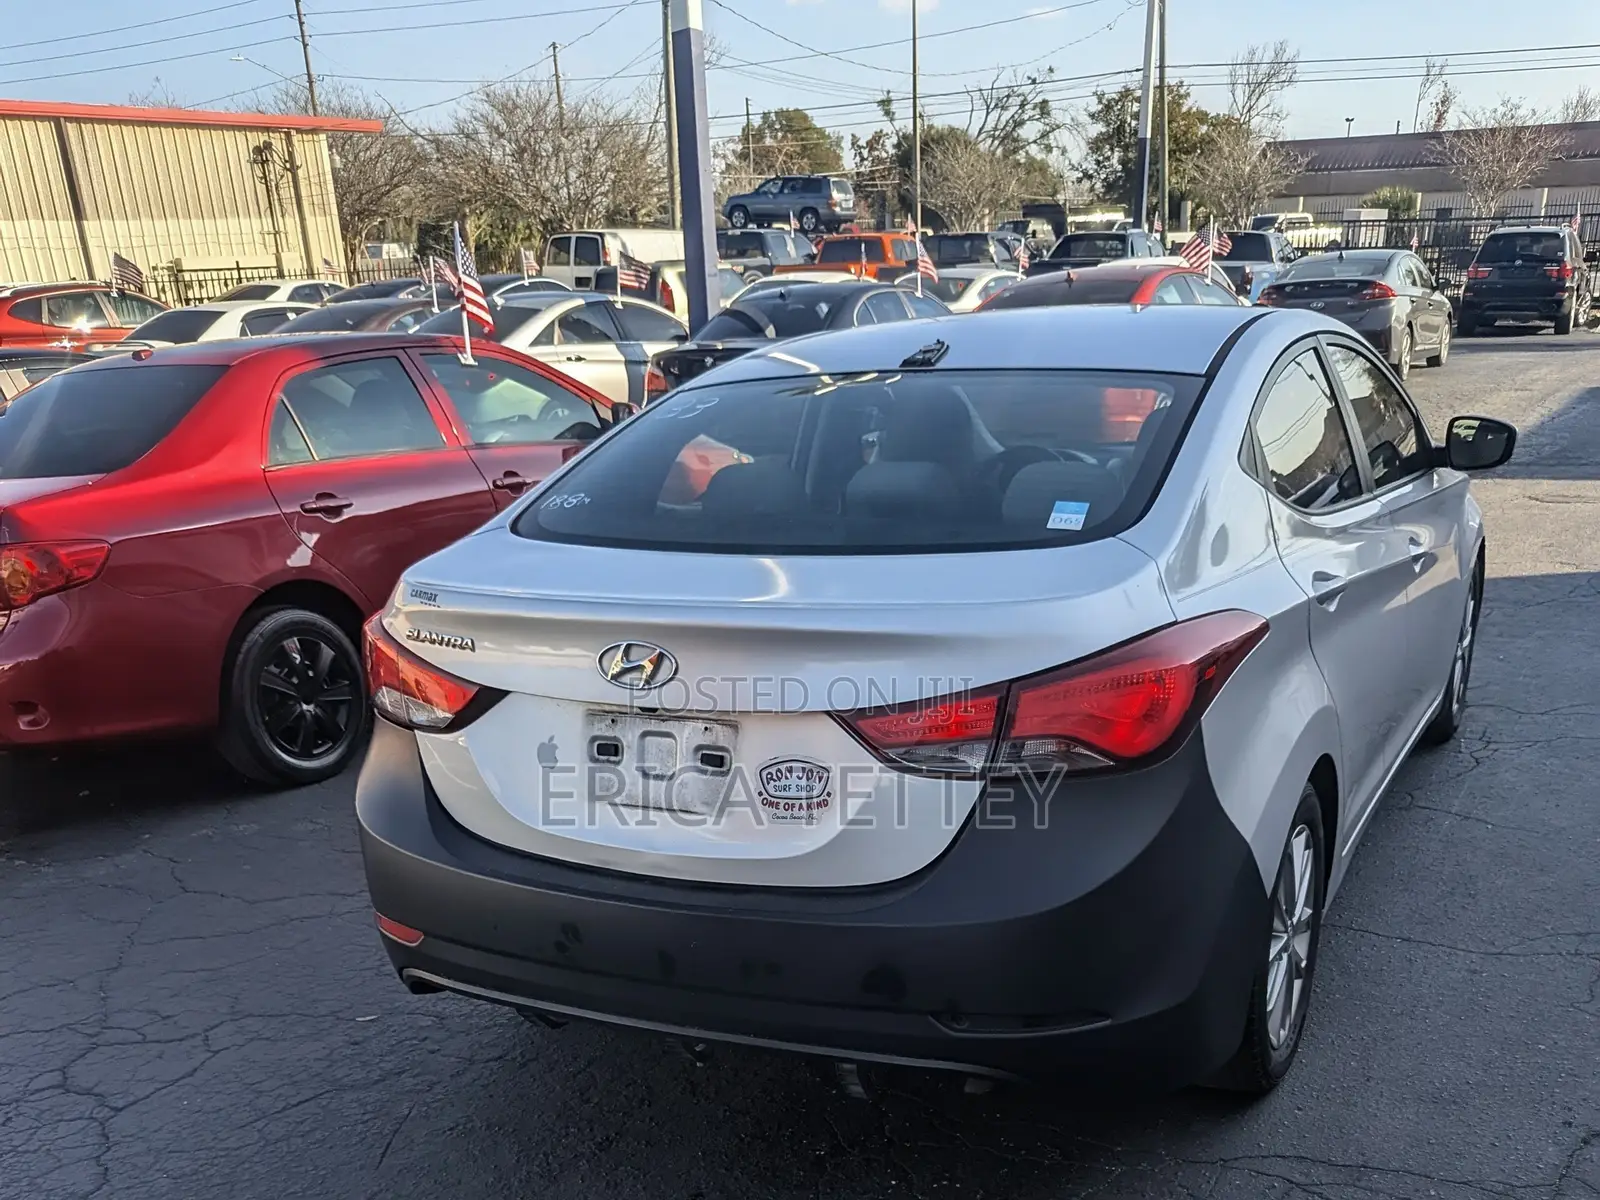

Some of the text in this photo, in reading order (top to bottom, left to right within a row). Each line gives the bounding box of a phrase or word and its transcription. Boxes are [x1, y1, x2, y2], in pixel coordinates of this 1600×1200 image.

[765, 765, 825, 785] RON JON
[773, 784, 817, 793] SURF SHOP
[761, 797, 829, 812] ONE OF A KIND
[771, 812, 788, 820] Cocoa
